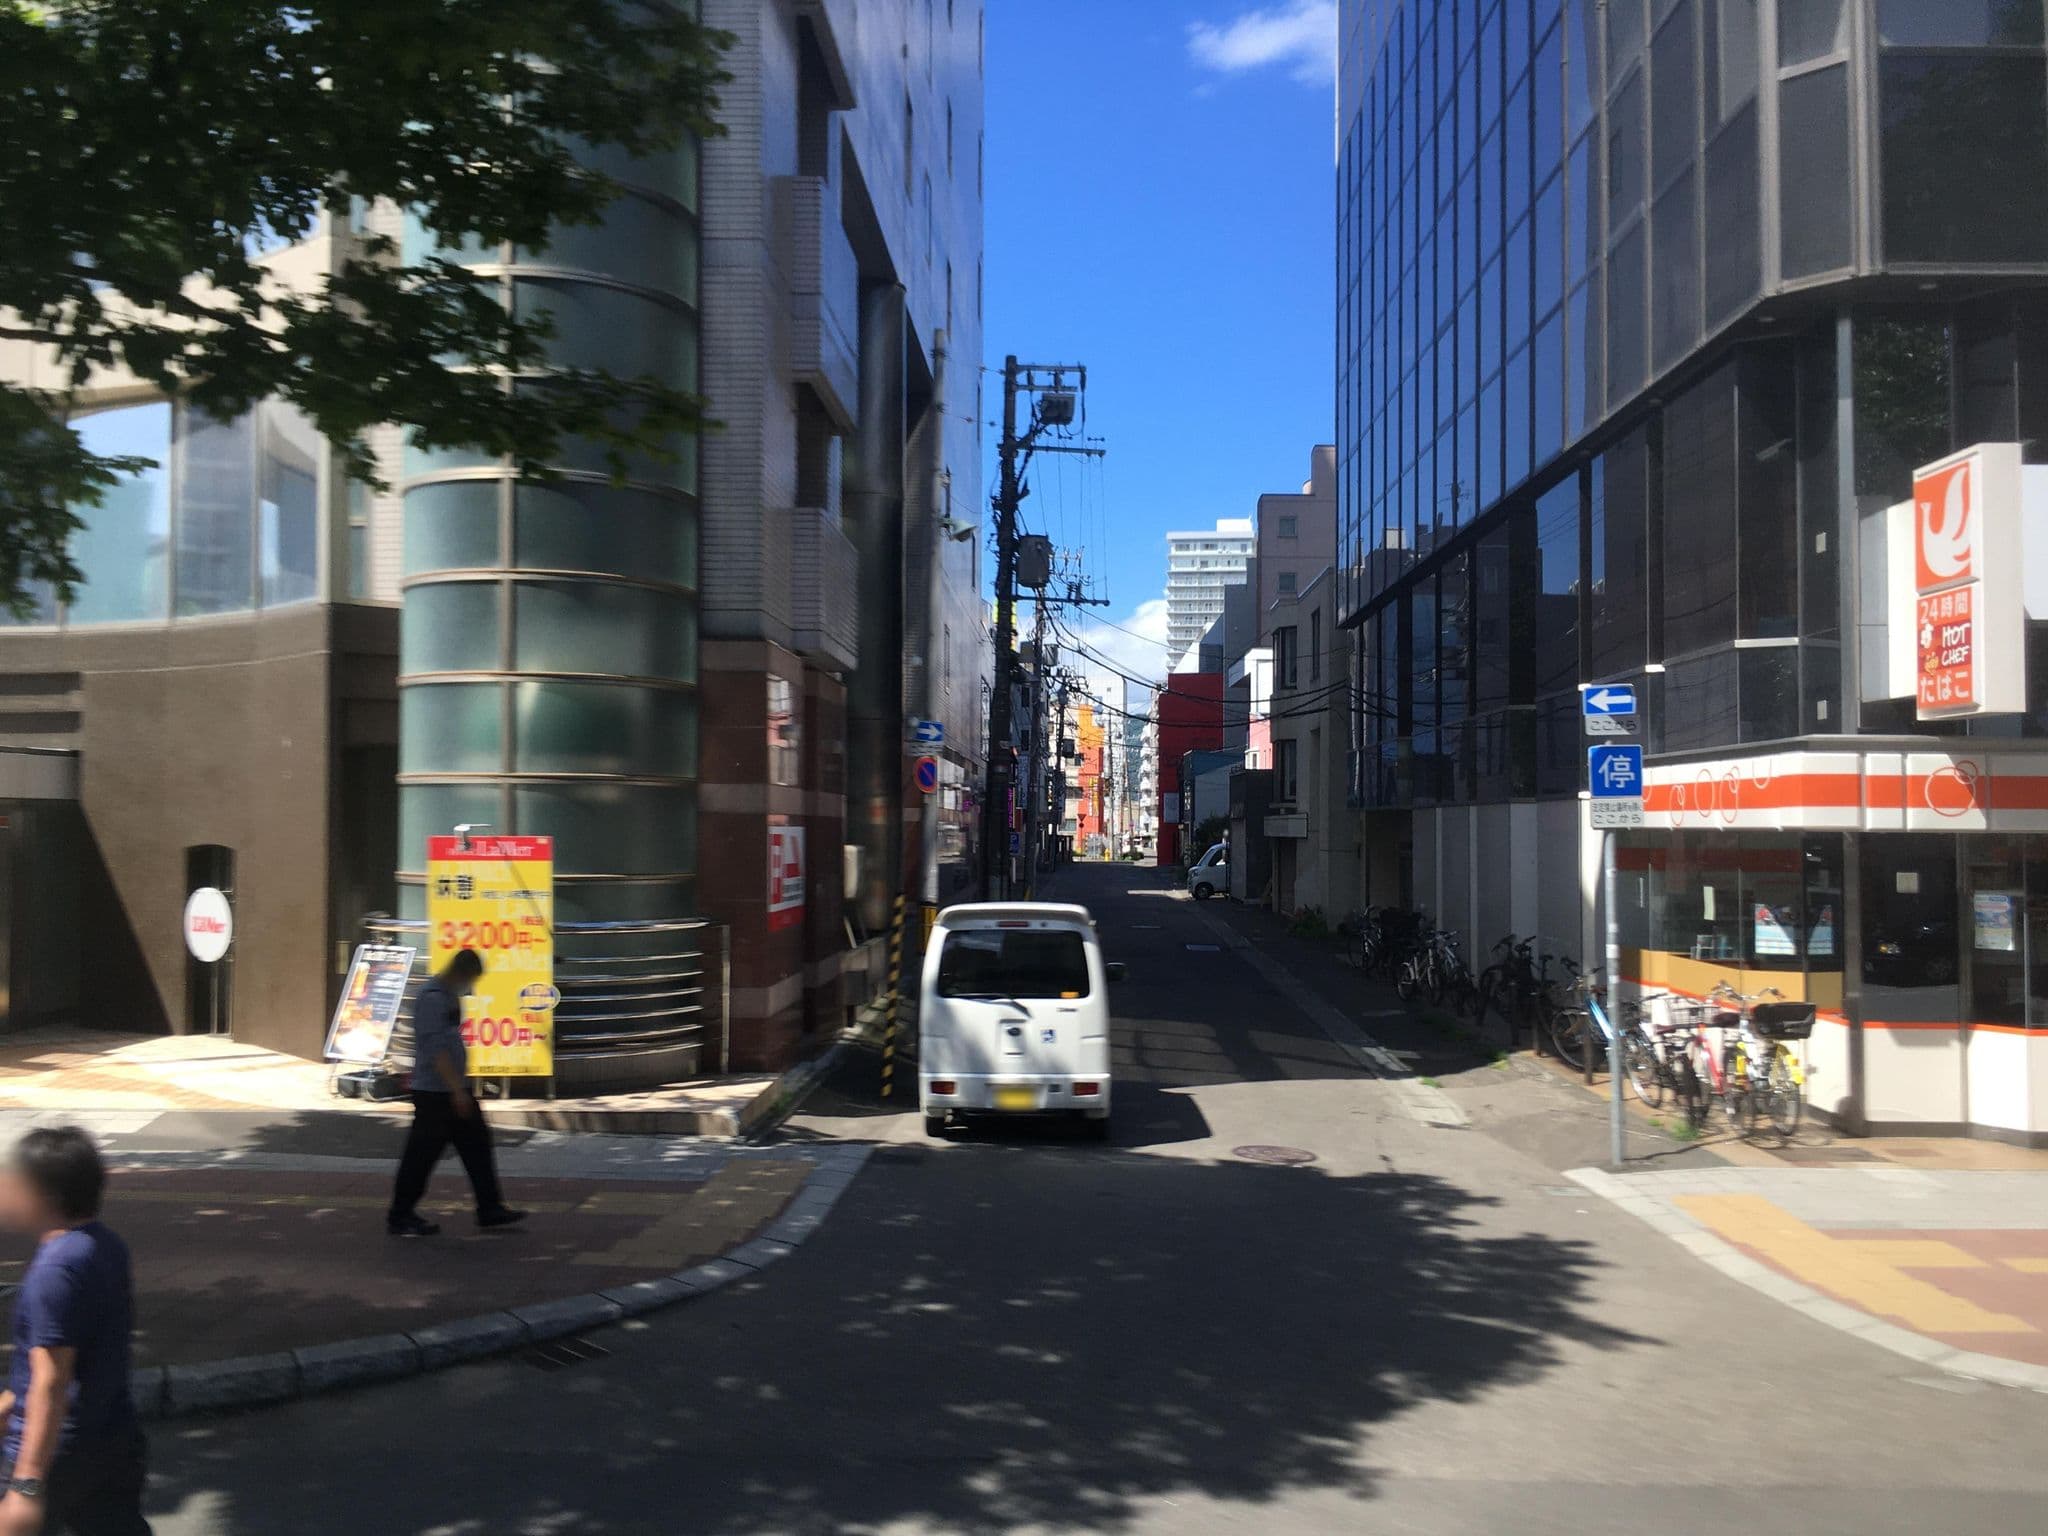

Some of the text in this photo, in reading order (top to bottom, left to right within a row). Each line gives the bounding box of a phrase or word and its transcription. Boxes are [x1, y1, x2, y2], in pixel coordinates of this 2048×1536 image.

[1920, 592, 1969, 621] 24時間
[1942, 622, 1970, 648] HOT
[1942, 645, 1970, 666] CHEF
[1920, 671, 1969, 702] たばこ
[1590, 719, 1637, 731] ここから
[1598, 754, 1636, 789] 停
[1594, 813, 1641, 824] ここから
